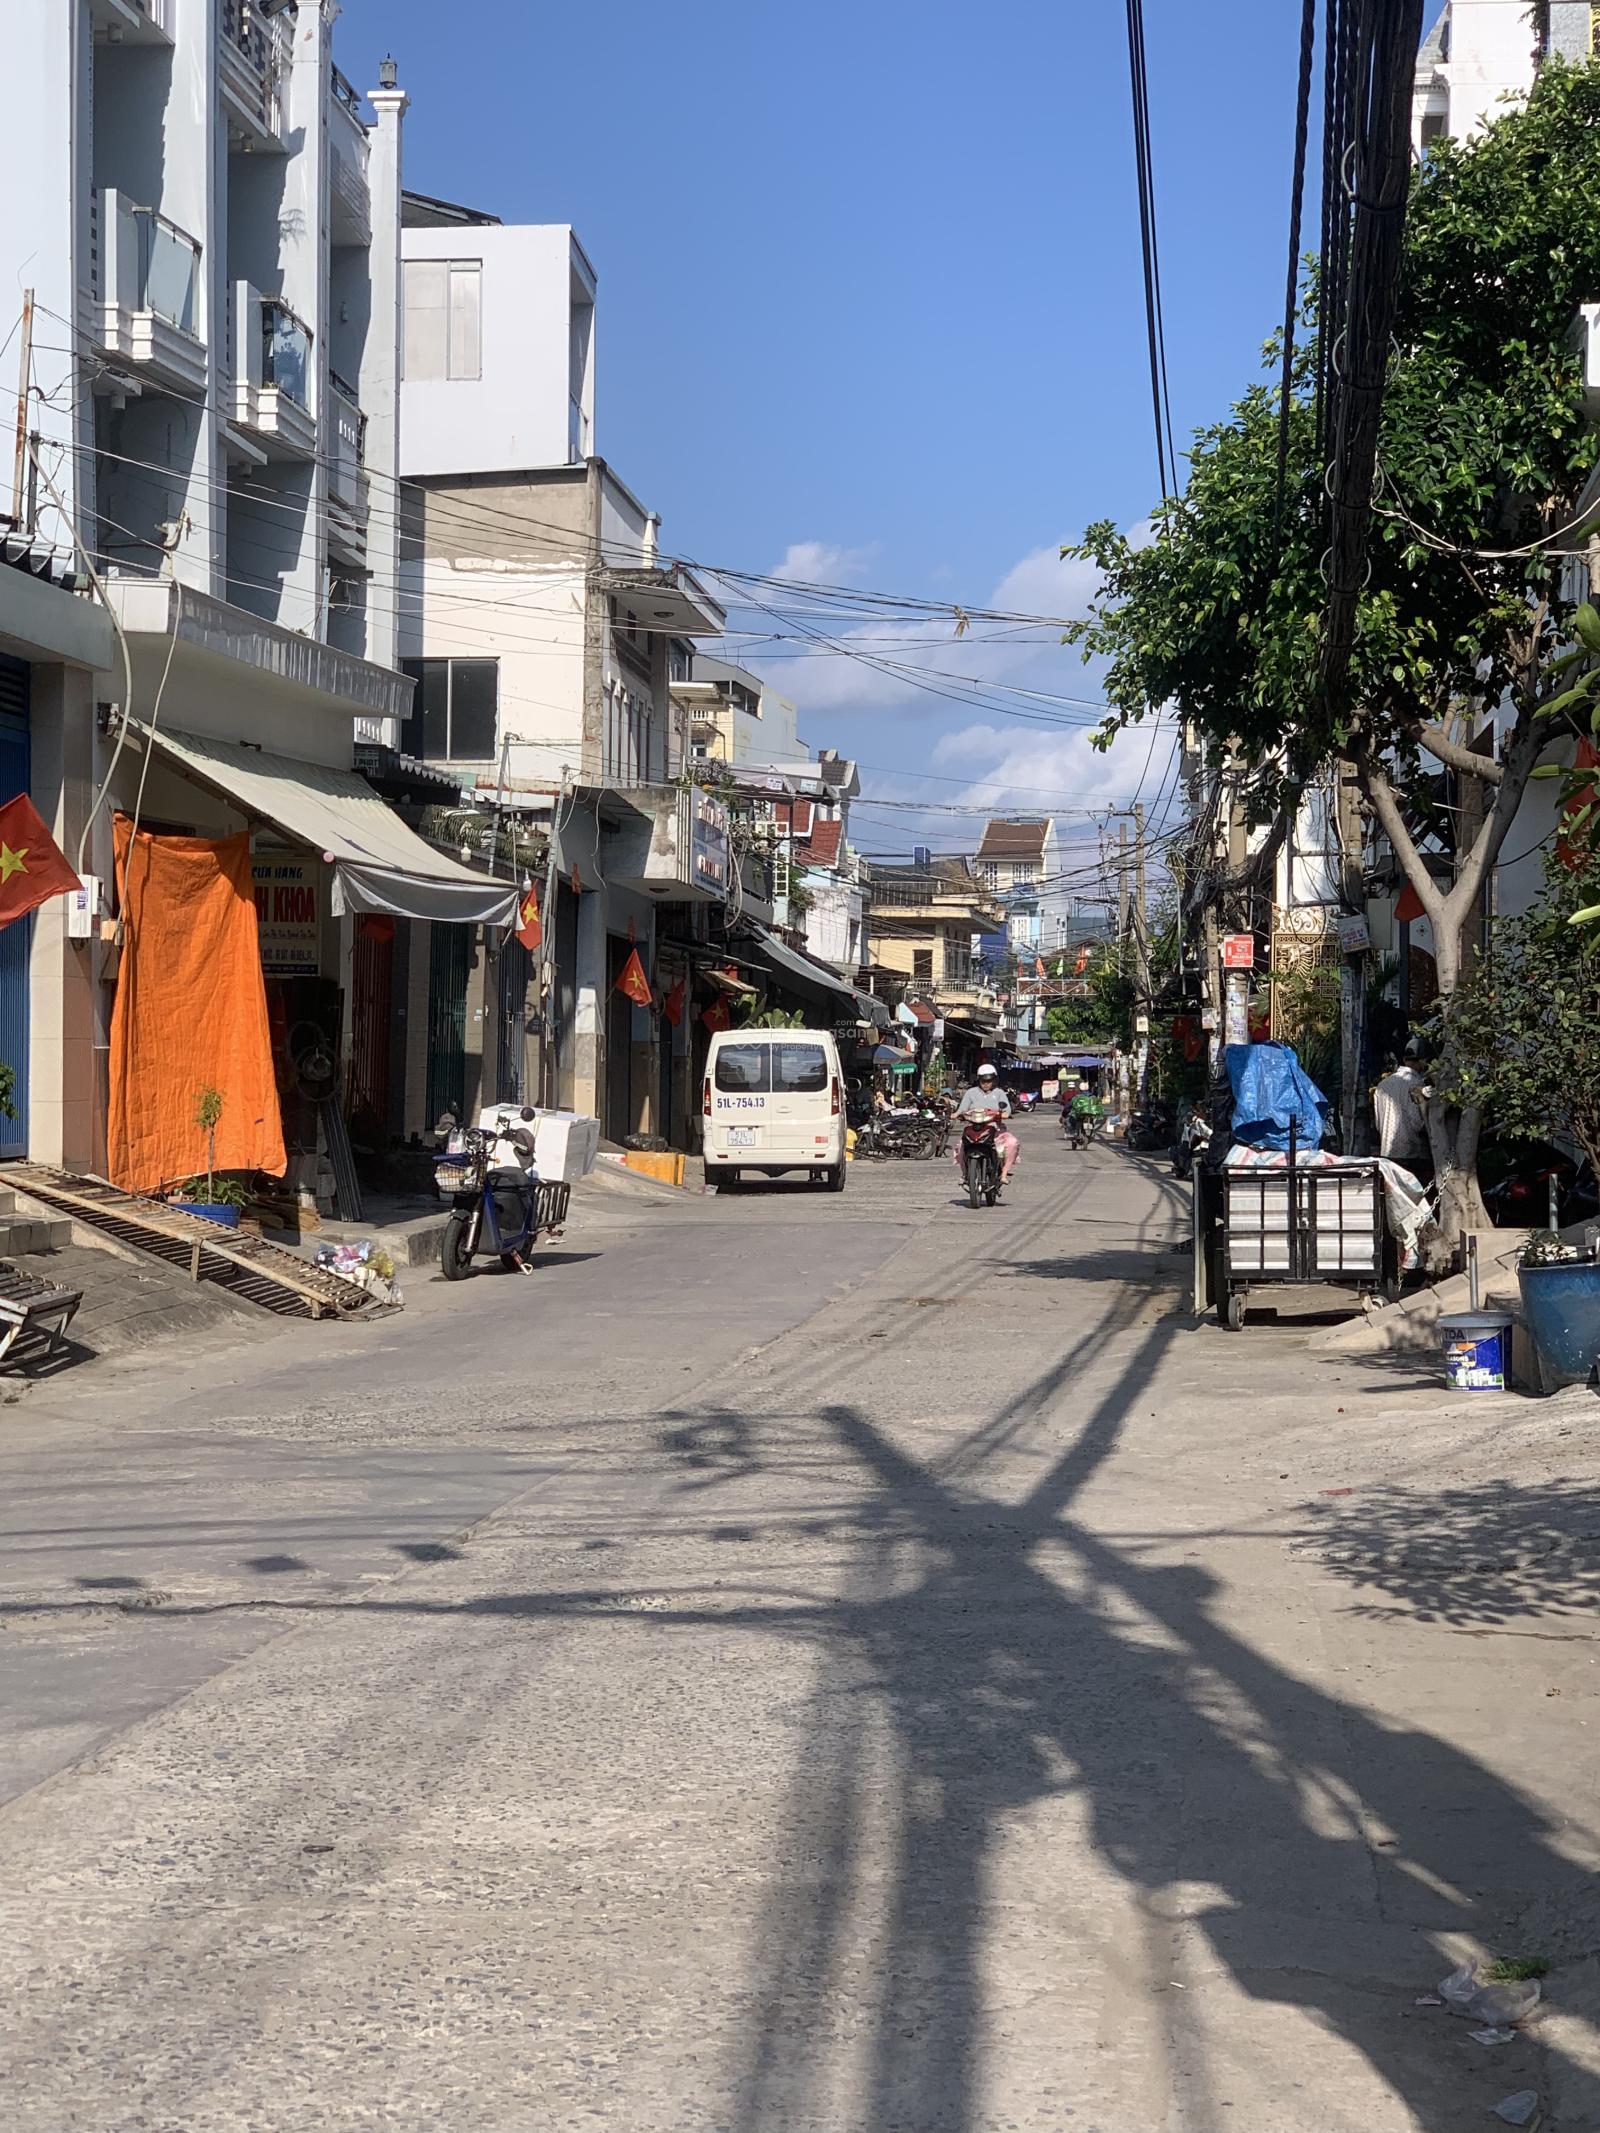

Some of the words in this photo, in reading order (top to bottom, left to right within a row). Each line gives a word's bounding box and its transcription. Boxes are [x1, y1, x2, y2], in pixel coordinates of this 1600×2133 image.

[273, 886, 315, 923] KHOA
[717, 1097, 765, 1109] 51L-754.13
[1443, 1328, 1466, 1340] TOA
